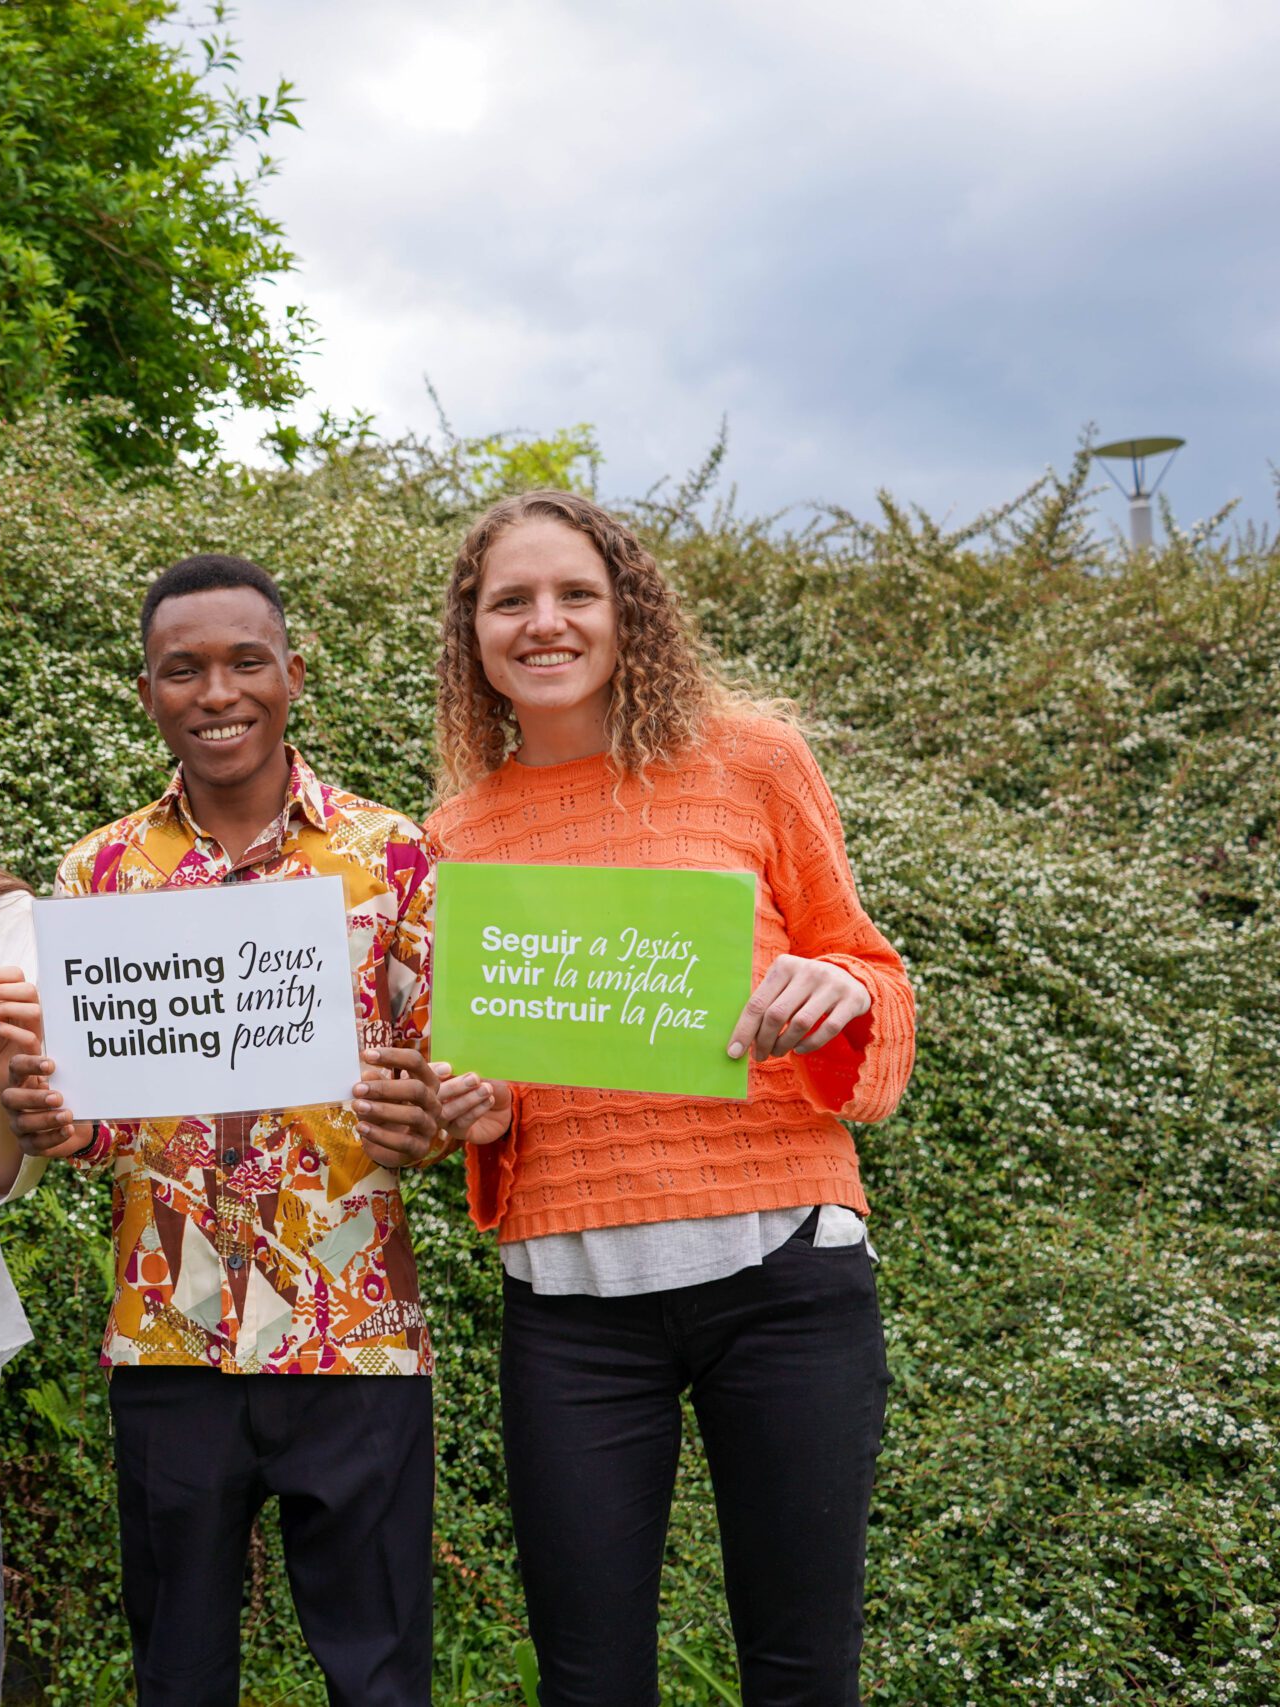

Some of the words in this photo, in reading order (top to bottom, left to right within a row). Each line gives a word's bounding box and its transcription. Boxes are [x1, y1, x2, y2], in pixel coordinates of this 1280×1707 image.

[64, 952, 225, 986] Following
[238, 941, 323, 980] Jesus,
[481, 925, 582, 959] Seguir
[588, 936, 608, 956] a
[482, 959, 545, 986] vivir
[553, 951, 578, 989] la
[587, 954, 700, 999] unidad,
[72, 993, 157, 1025] living
[168, 988, 225, 1017] out
[236, 974, 322, 1027] unity,
[470, 994, 611, 1023] construir
[620, 987, 645, 1025] la
[649, 1002, 709, 1046] paz
[87, 1026, 221, 1058] building
[230, 1020, 315, 1071] peace
